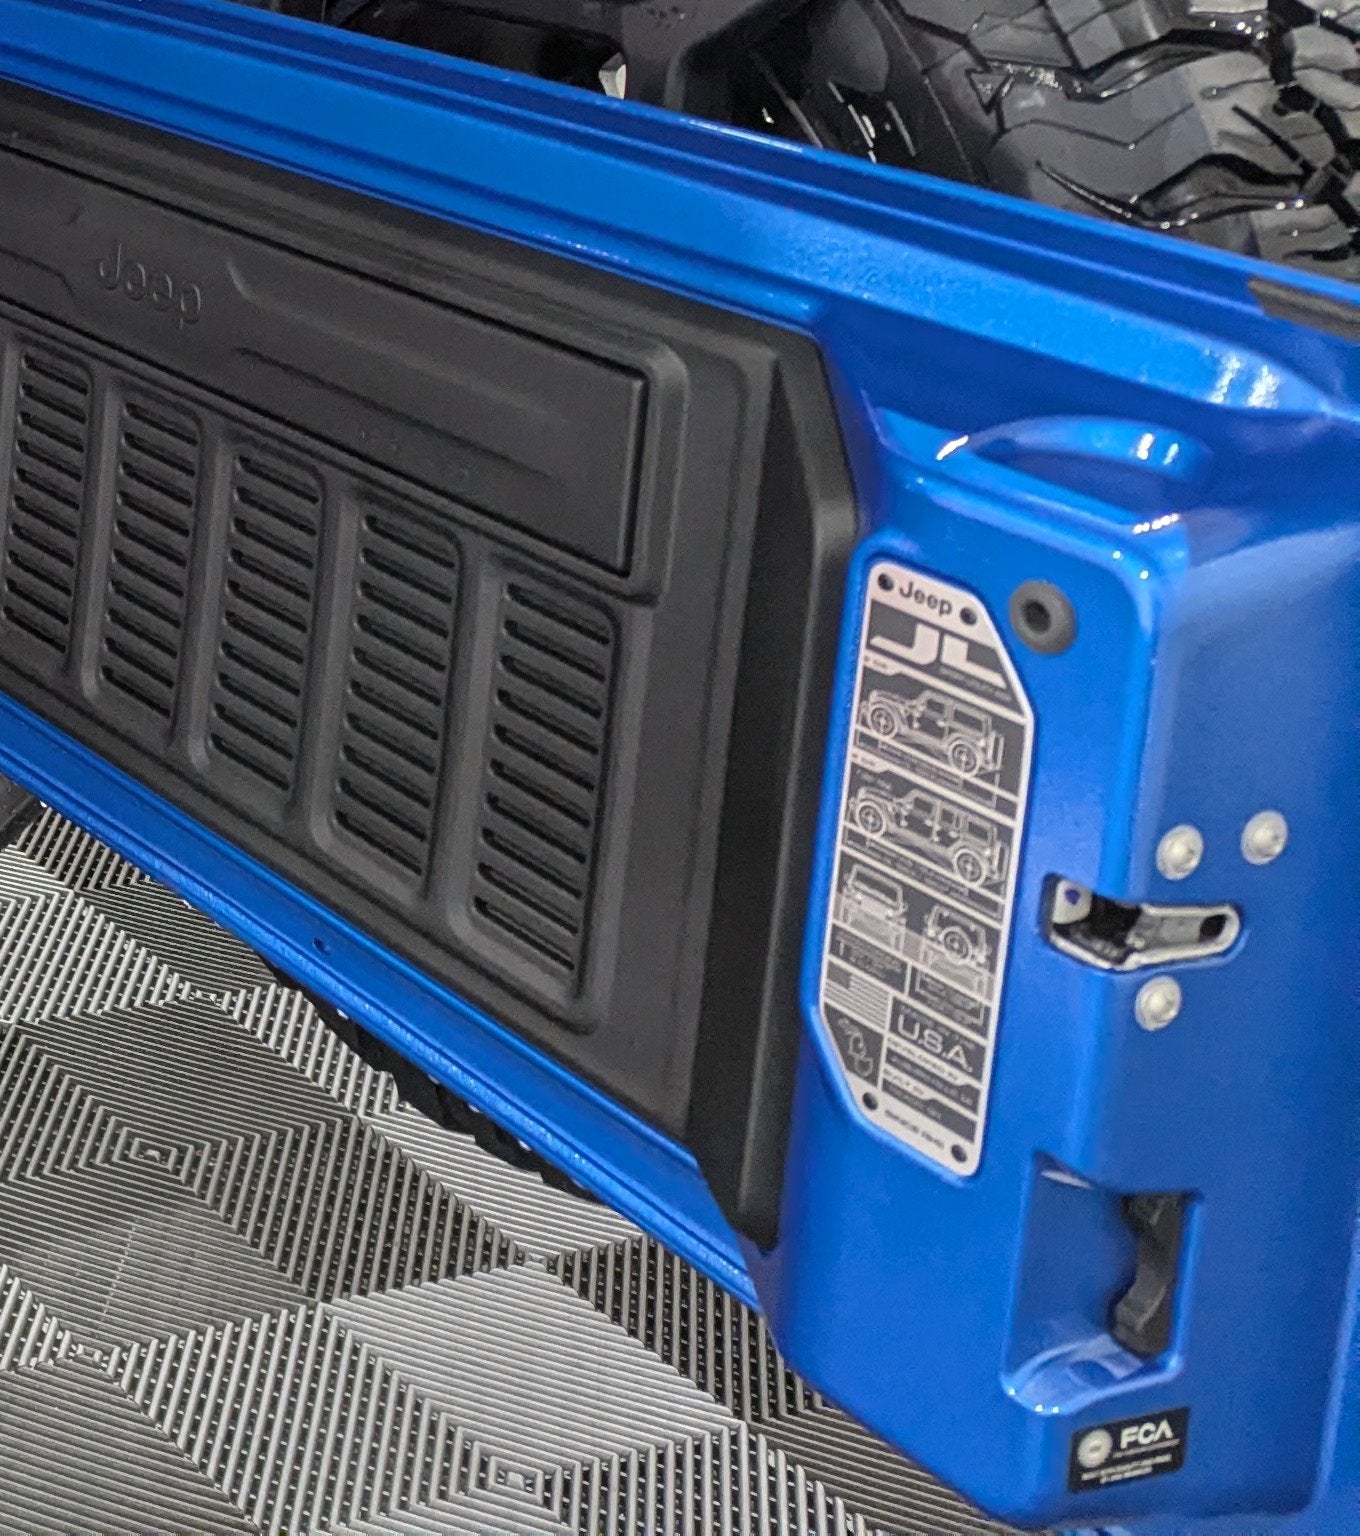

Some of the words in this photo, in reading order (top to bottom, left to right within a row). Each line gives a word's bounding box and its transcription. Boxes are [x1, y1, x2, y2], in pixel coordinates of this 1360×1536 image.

[99, 242, 202, 331] Jeep
[897, 579, 954, 618] Jeep
[870, 623, 1007, 689] JL
[1119, 1418, 1174, 1449] FCA
